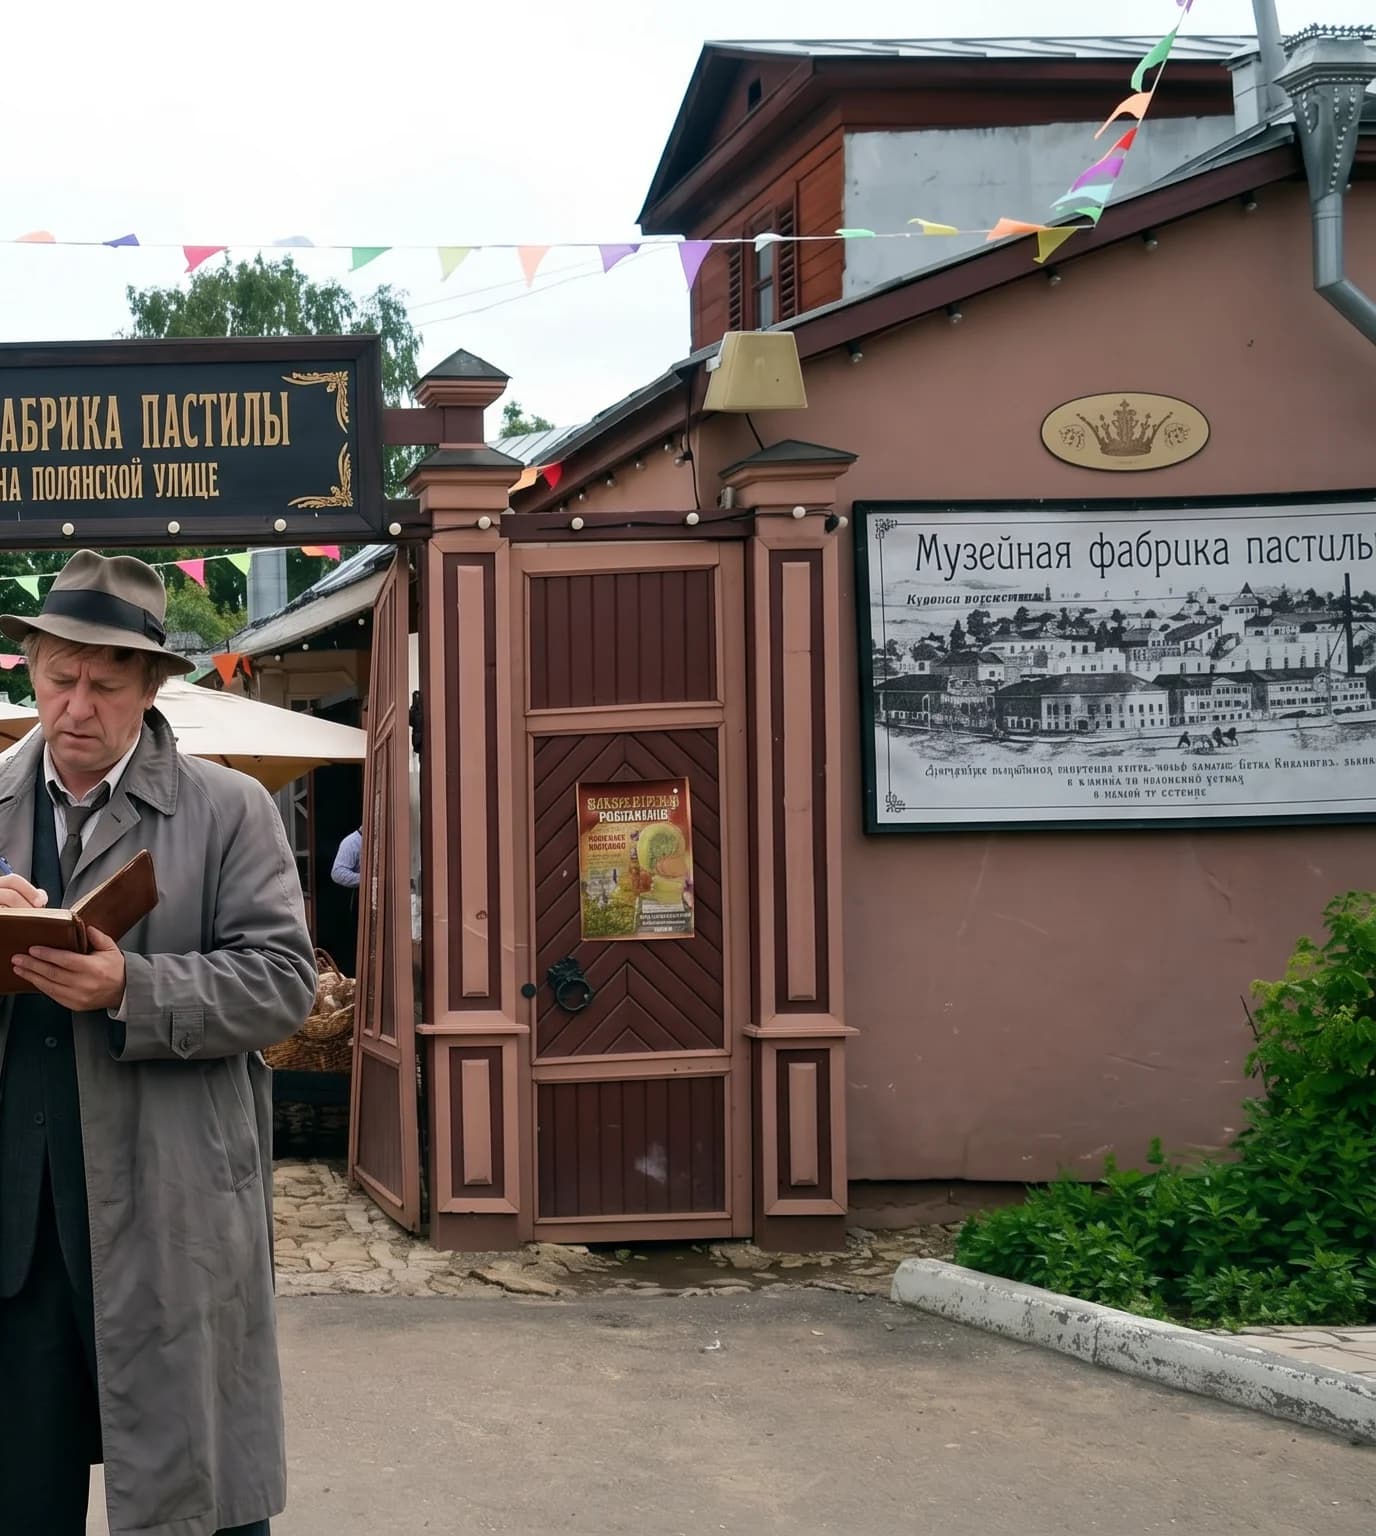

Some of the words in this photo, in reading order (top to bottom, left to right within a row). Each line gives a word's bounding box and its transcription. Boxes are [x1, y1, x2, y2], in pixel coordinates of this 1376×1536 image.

[140, 391, 291, 449] ПАСТИЛЫ
[31, 457, 144, 501] ПОЛЯНСКОЙ
[152, 462, 220, 500] УЛИЦЕ
[915, 533, 1072, 581] Музейная
[1089, 529, 1230, 579] фабрика
